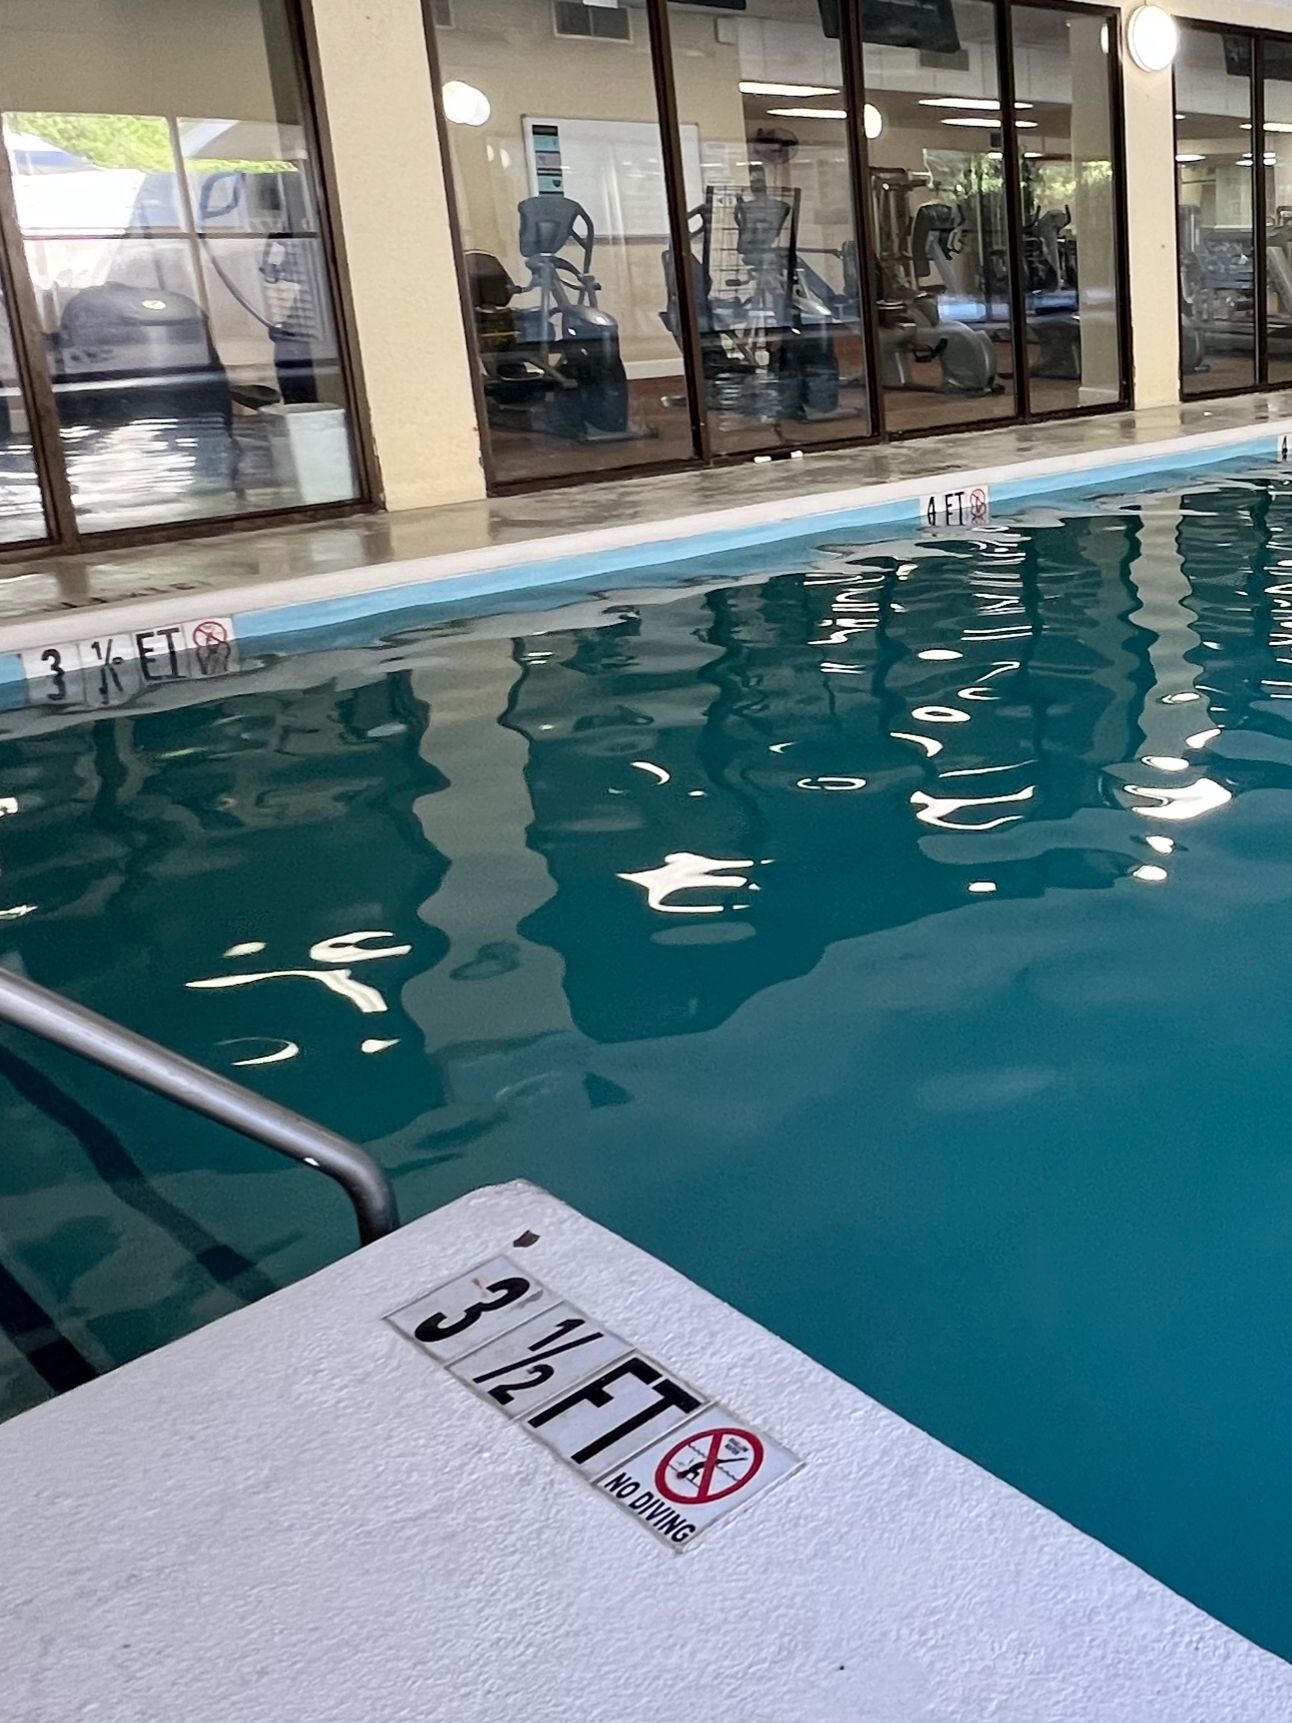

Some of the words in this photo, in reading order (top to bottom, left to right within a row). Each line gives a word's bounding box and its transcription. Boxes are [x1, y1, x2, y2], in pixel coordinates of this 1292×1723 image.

[414, 1276, 530, 1343] 3
[527, 1356, 703, 1465] FT
[604, 1472, 640, 1499] NO
[628, 1491, 696, 1542] DIVING
